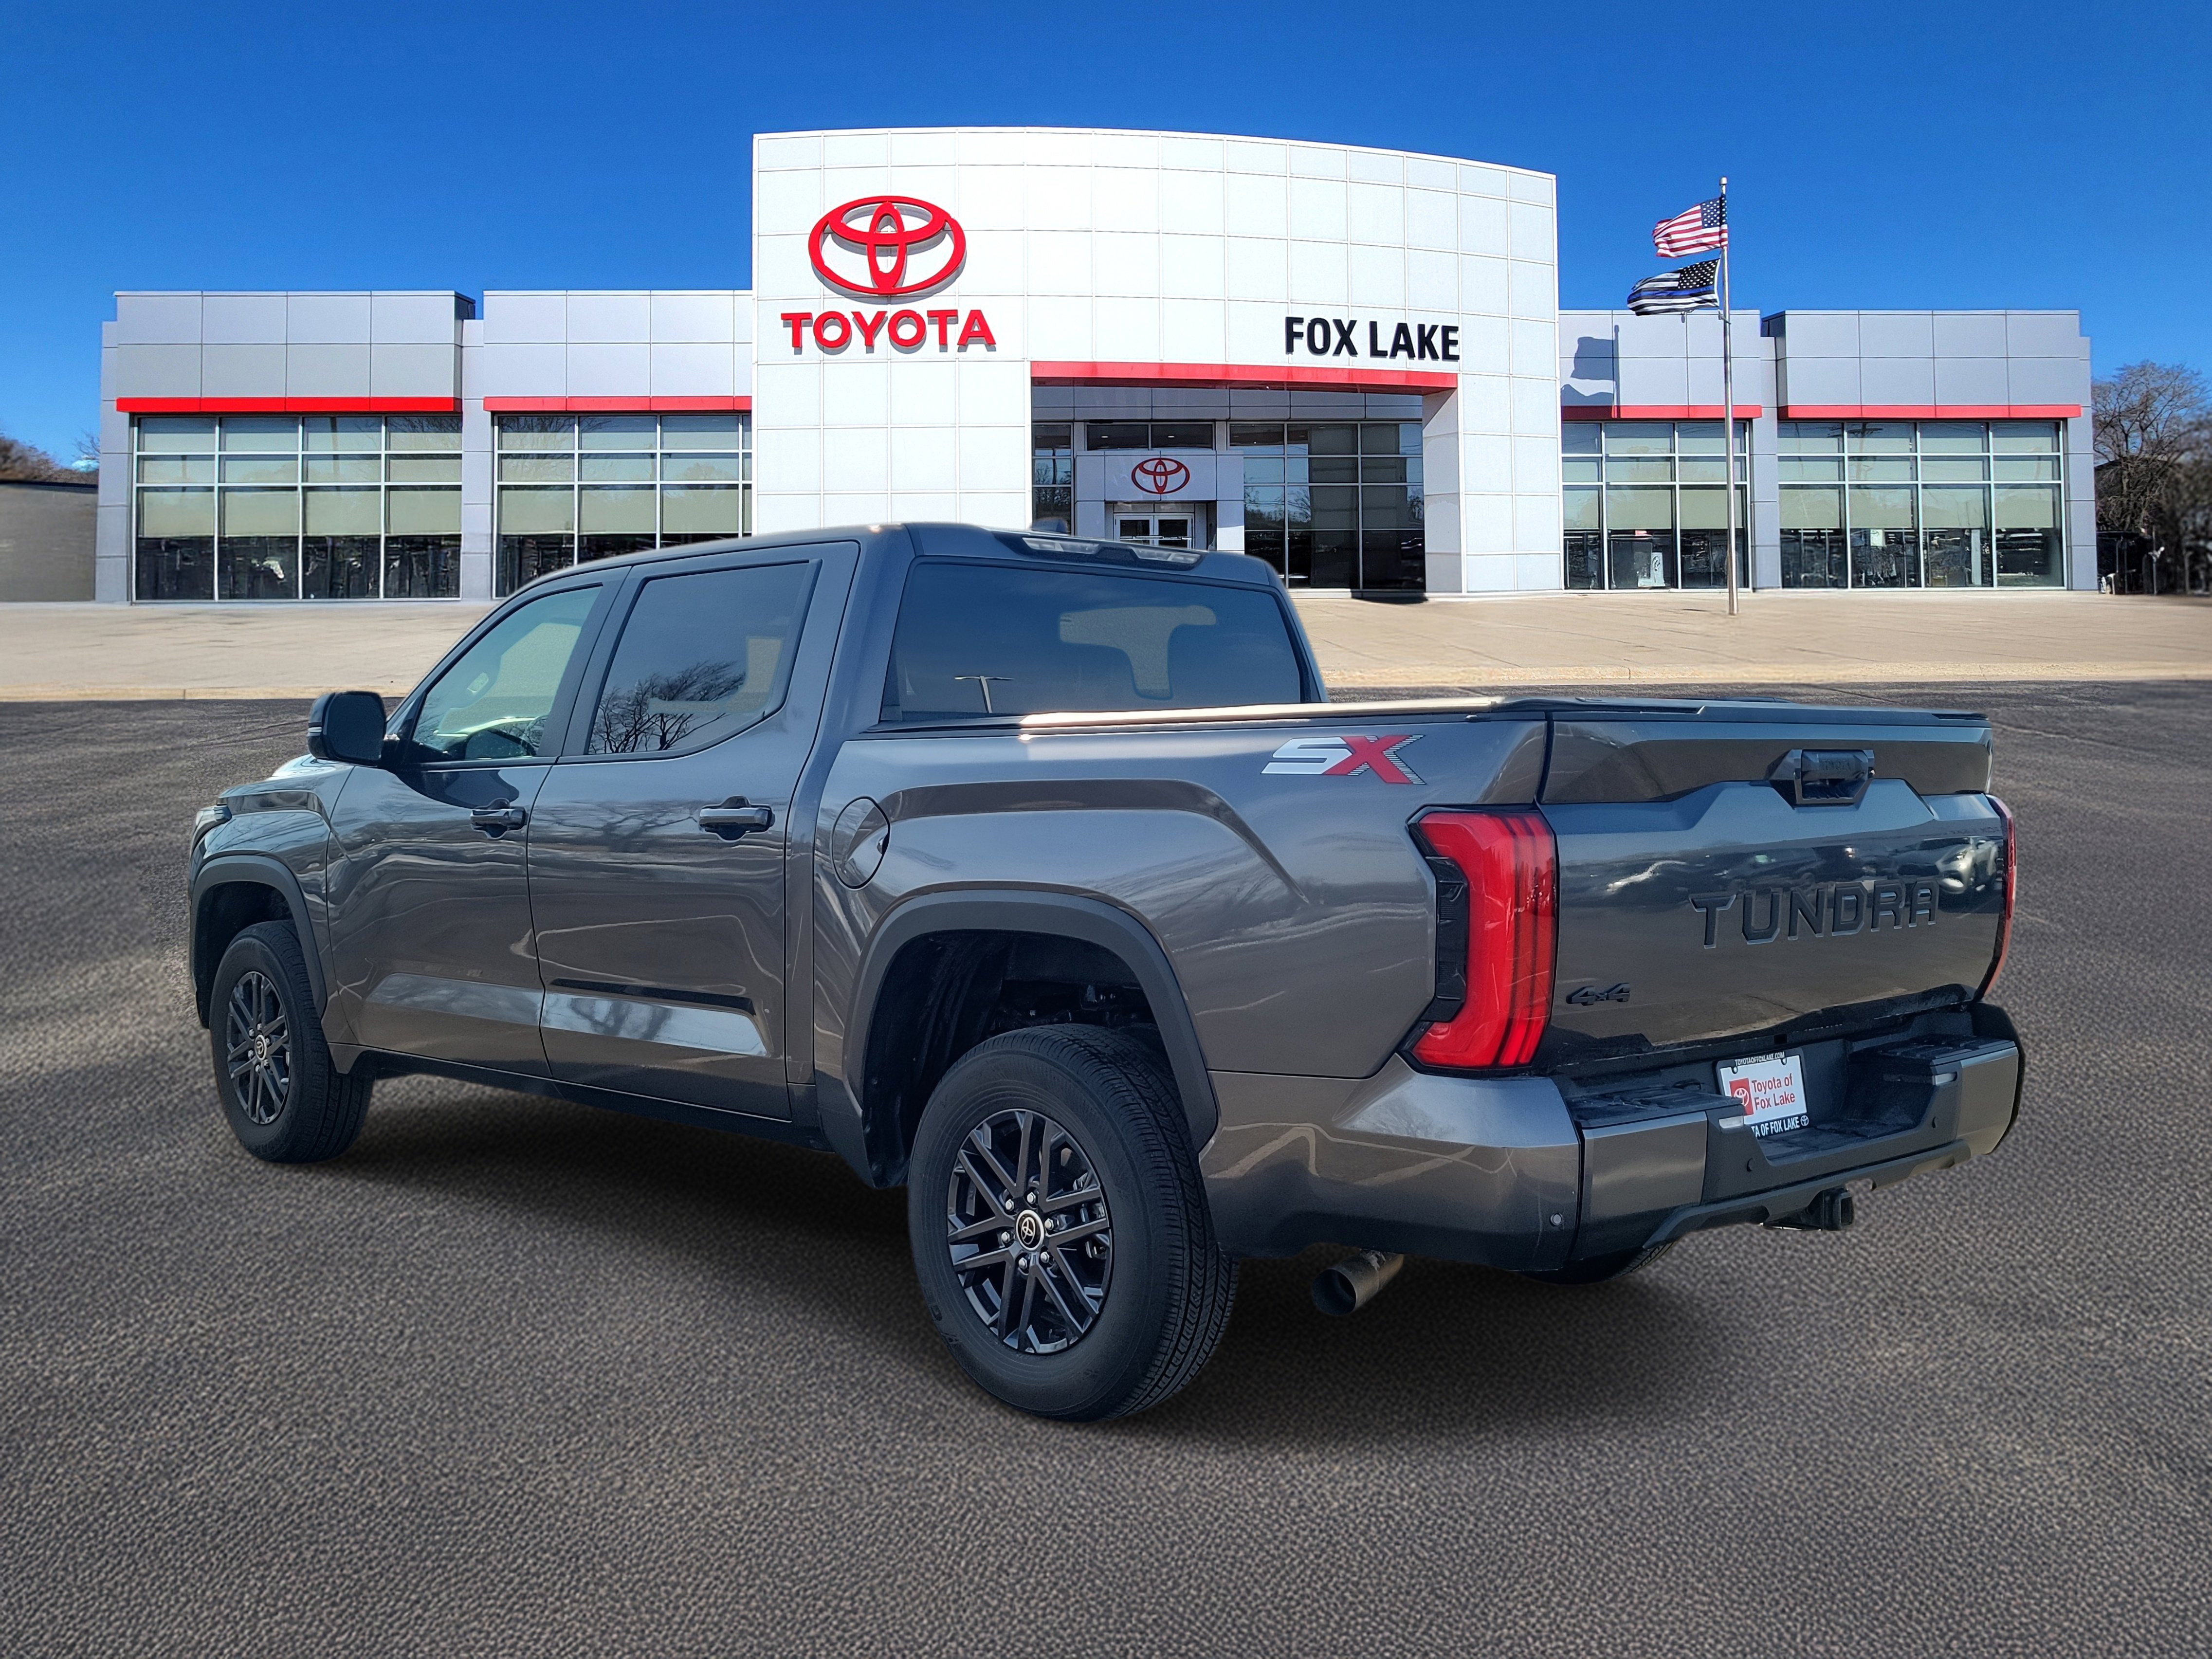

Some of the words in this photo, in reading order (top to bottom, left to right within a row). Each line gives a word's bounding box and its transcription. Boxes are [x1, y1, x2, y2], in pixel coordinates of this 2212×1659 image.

[781, 310, 997, 348] TOYOTA
[1285, 316, 1358, 357] FOX
[1369, 321, 1460, 360] LAKE
[1689, 879, 1939, 948] TUNDRA
[1735, 1051, 1785, 1066] TOYOTAOFFOXLAKE.COM
[1752, 1077, 1782, 1094] Toyota
[1784, 1073, 1793, 1086] of
[1754, 1096, 1772, 1111] Fox
[1773, 1091, 1795, 1106] Lake
[1760, 1123, 1770, 1136] OF
[1770, 1120, 1783, 1134] FOX
[1783, 1116, 1800, 1130] LAKE
